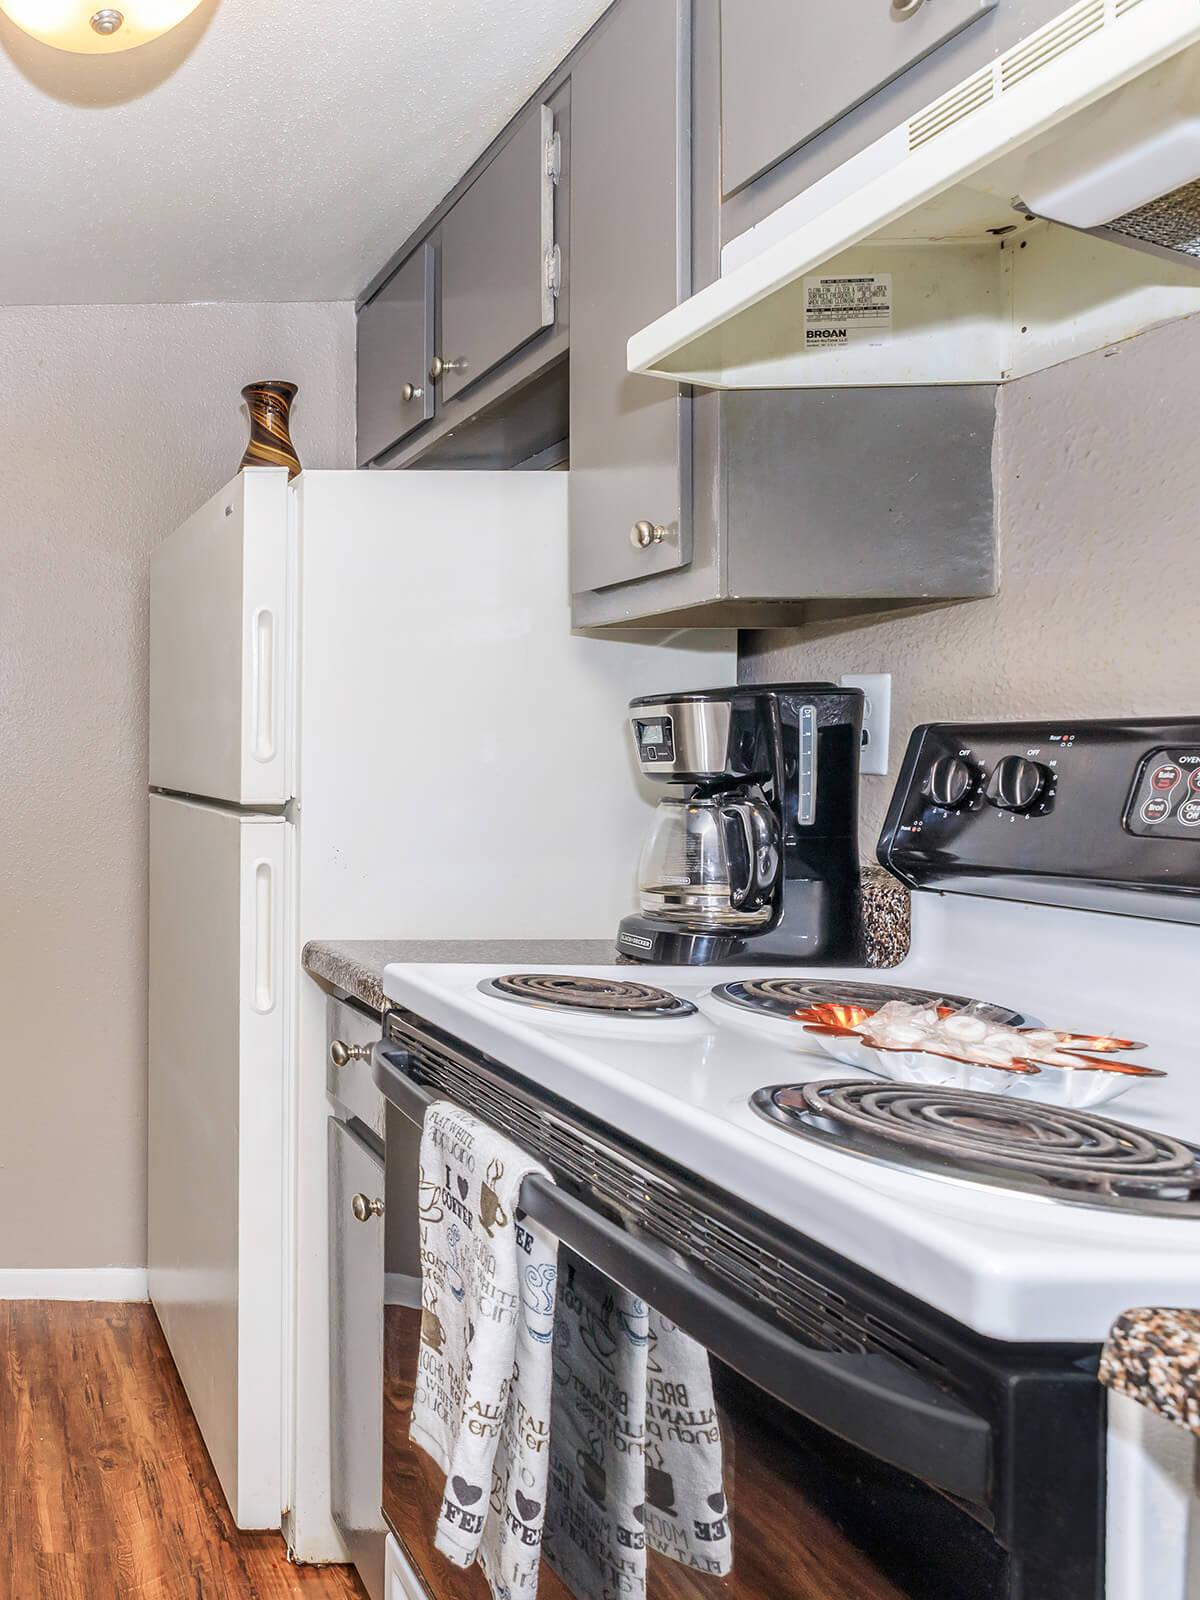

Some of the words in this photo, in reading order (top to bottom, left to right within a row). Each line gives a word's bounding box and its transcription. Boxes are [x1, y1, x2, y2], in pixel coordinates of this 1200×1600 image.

[806, 329, 847, 338] BROAN
[429, 1111, 450, 1137] FLAT
[450, 1121, 476, 1150] WHITE
